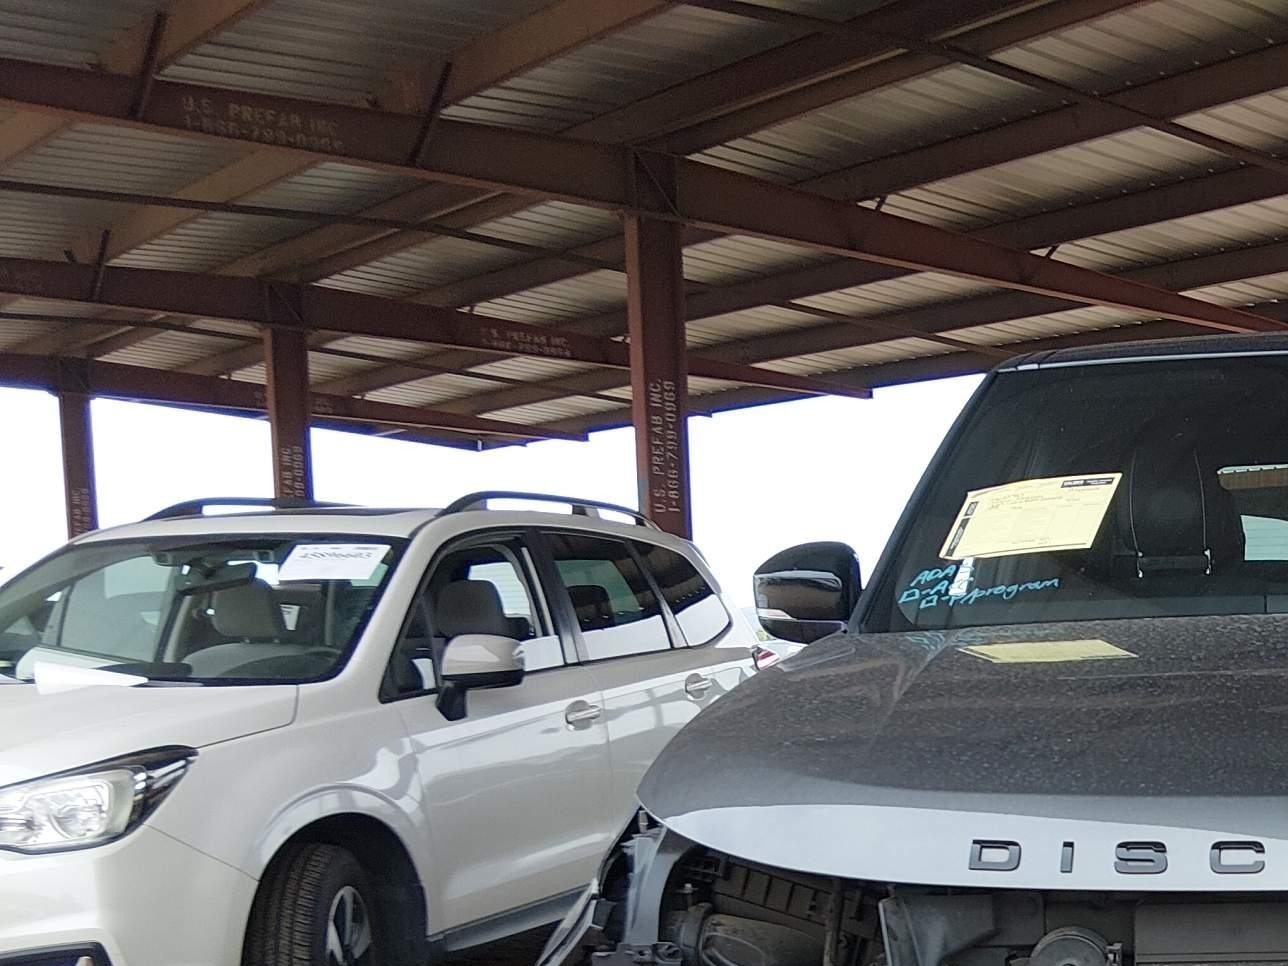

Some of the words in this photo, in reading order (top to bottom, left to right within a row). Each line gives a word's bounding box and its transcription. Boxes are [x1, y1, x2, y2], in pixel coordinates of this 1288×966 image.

[650, 378, 663, 407] INC.
[651, 415, 665, 475] PREFAB
[910, 565, 956, 586] ADA
